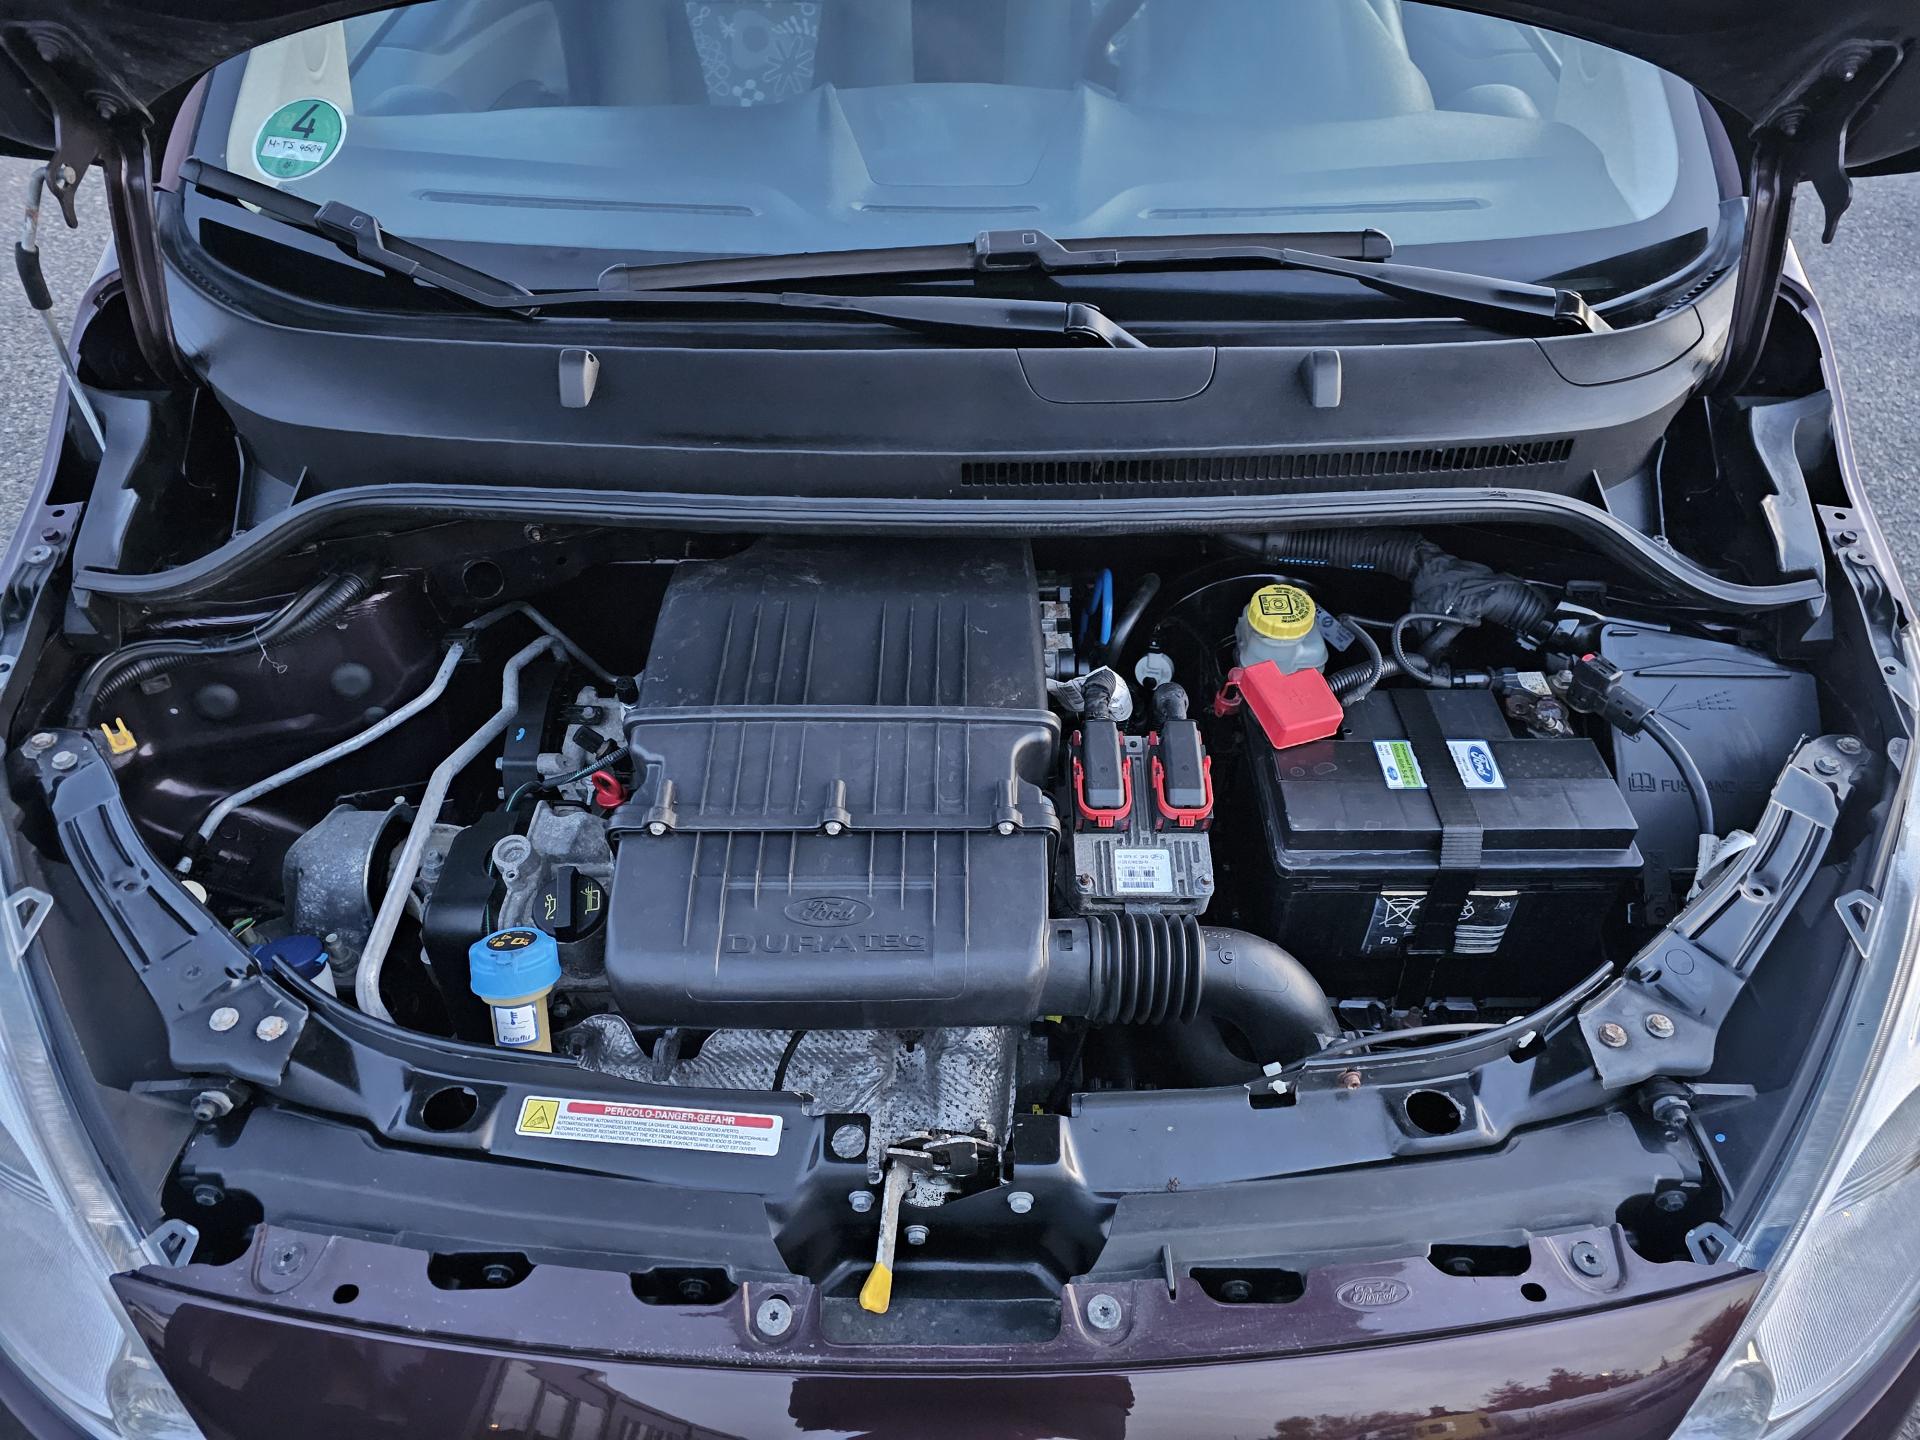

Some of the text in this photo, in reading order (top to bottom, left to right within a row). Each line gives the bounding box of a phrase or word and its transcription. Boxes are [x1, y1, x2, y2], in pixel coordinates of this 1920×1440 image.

[291, 103, 320, 139] 4
[1470, 751, 1491, 777] Ford
[1661, 779, 1691, 793] FUS
[802, 900, 857, 922] Ford
[725, 933, 926, 954] DURATEC
[1380, 936, 1398, 945] Pb
[603, 1106, 736, 1126] PERICOLO-DANGER-GEFAHR
[1352, 1281, 1398, 1305] Ford
